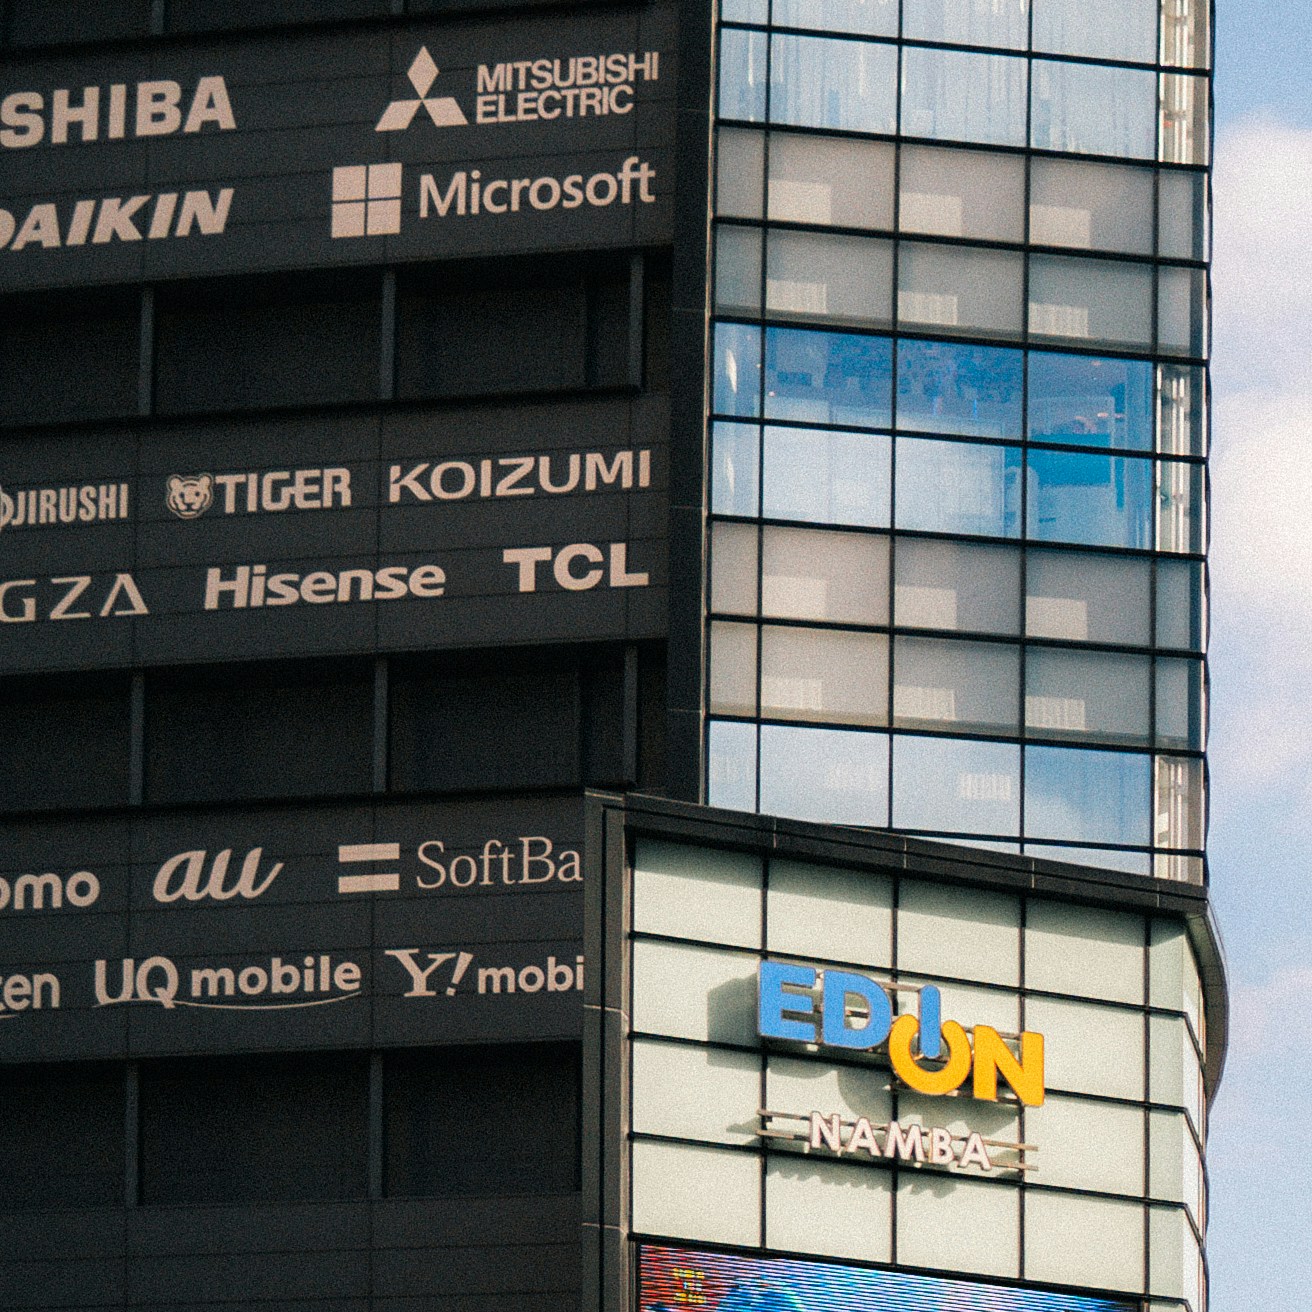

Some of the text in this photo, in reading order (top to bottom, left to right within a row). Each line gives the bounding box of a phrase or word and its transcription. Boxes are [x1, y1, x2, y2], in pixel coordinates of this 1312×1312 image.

[477, 52, 658, 93] MITSUBISHI
[0, 76, 236, 148] SHIBA
[477, 86, 634, 124] ELECTRIC
[419, 157, 656, 218] Microsoft
[215, 468, 352, 513] TIGER
[390, 450, 651, 502] KOIZUMI
[205, 564, 447, 610] Hisense
[503, 543, 649, 592] TCL
[0, 573, 149, 622] GZA
[152, 847, 285, 902] au
[416, 836, 584, 889] SoftBa
[0, 972, 61, 1010] en
[95, 955, 362, 1008] UQ mobile
[759, 959, 1045, 1107] EDION
[809, 1111, 992, 1172] NAMBA
